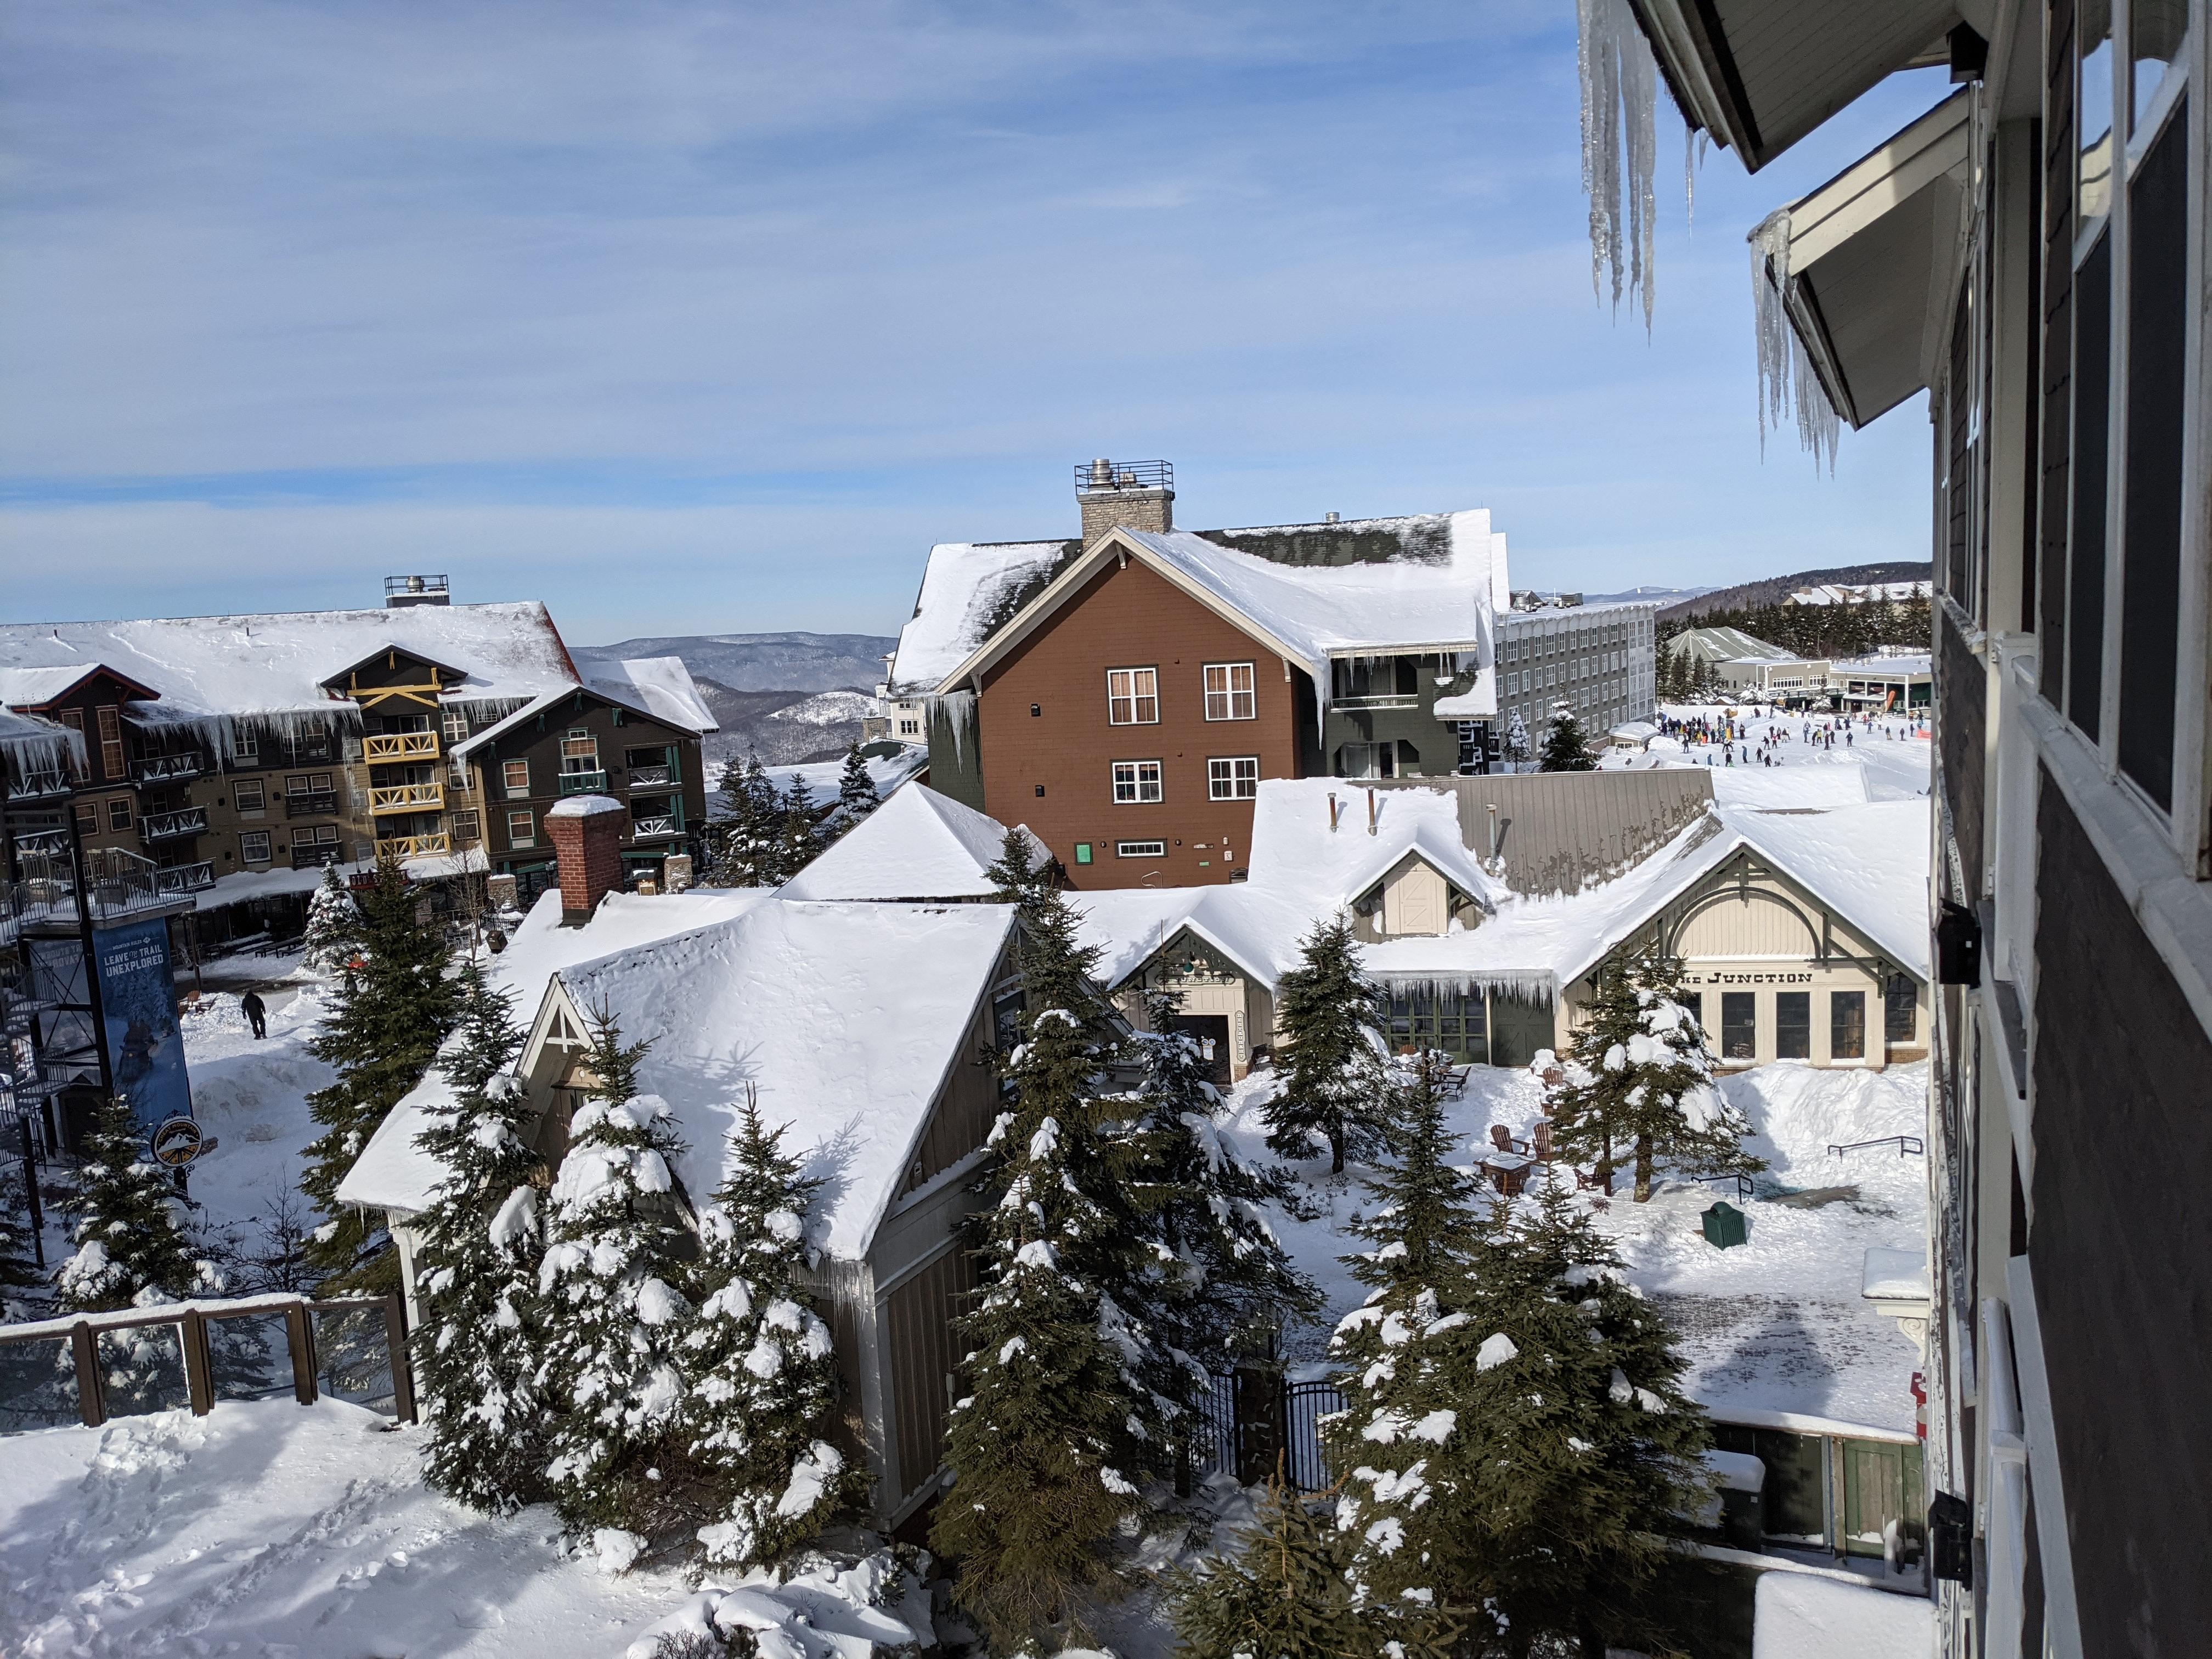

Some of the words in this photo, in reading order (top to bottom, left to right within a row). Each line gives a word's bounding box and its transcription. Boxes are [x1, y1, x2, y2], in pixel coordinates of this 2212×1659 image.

[352, 875, 367, 885] OLD
[104, 952, 129, 966] LEAVE
[139, 944, 162, 957] TRAIL
[106, 954, 163, 977] UNEXPLORED
[1707, 972, 1813, 984] JUNCTION
[172, 1122, 198, 1134] MOUNTAIN
